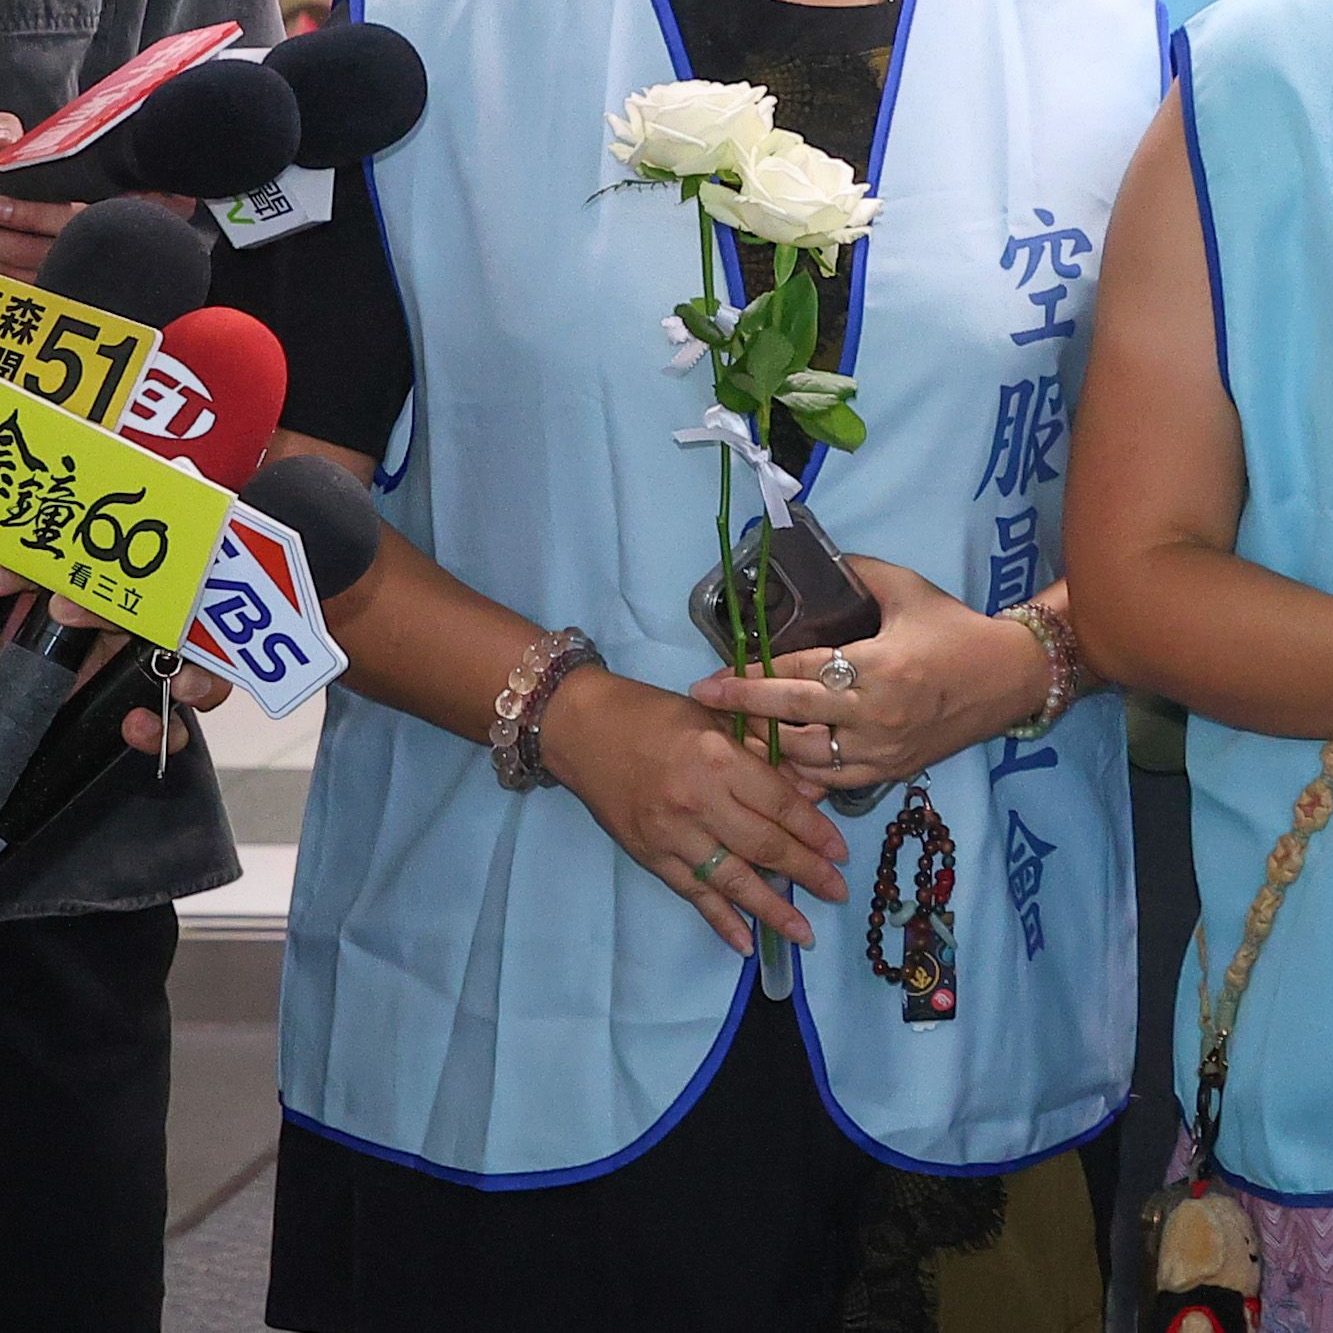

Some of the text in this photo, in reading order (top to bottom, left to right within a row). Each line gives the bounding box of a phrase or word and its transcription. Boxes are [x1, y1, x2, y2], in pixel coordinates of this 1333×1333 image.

[24, 314, 139, 424] 51
[68, 561, 144, 616] 看三立
